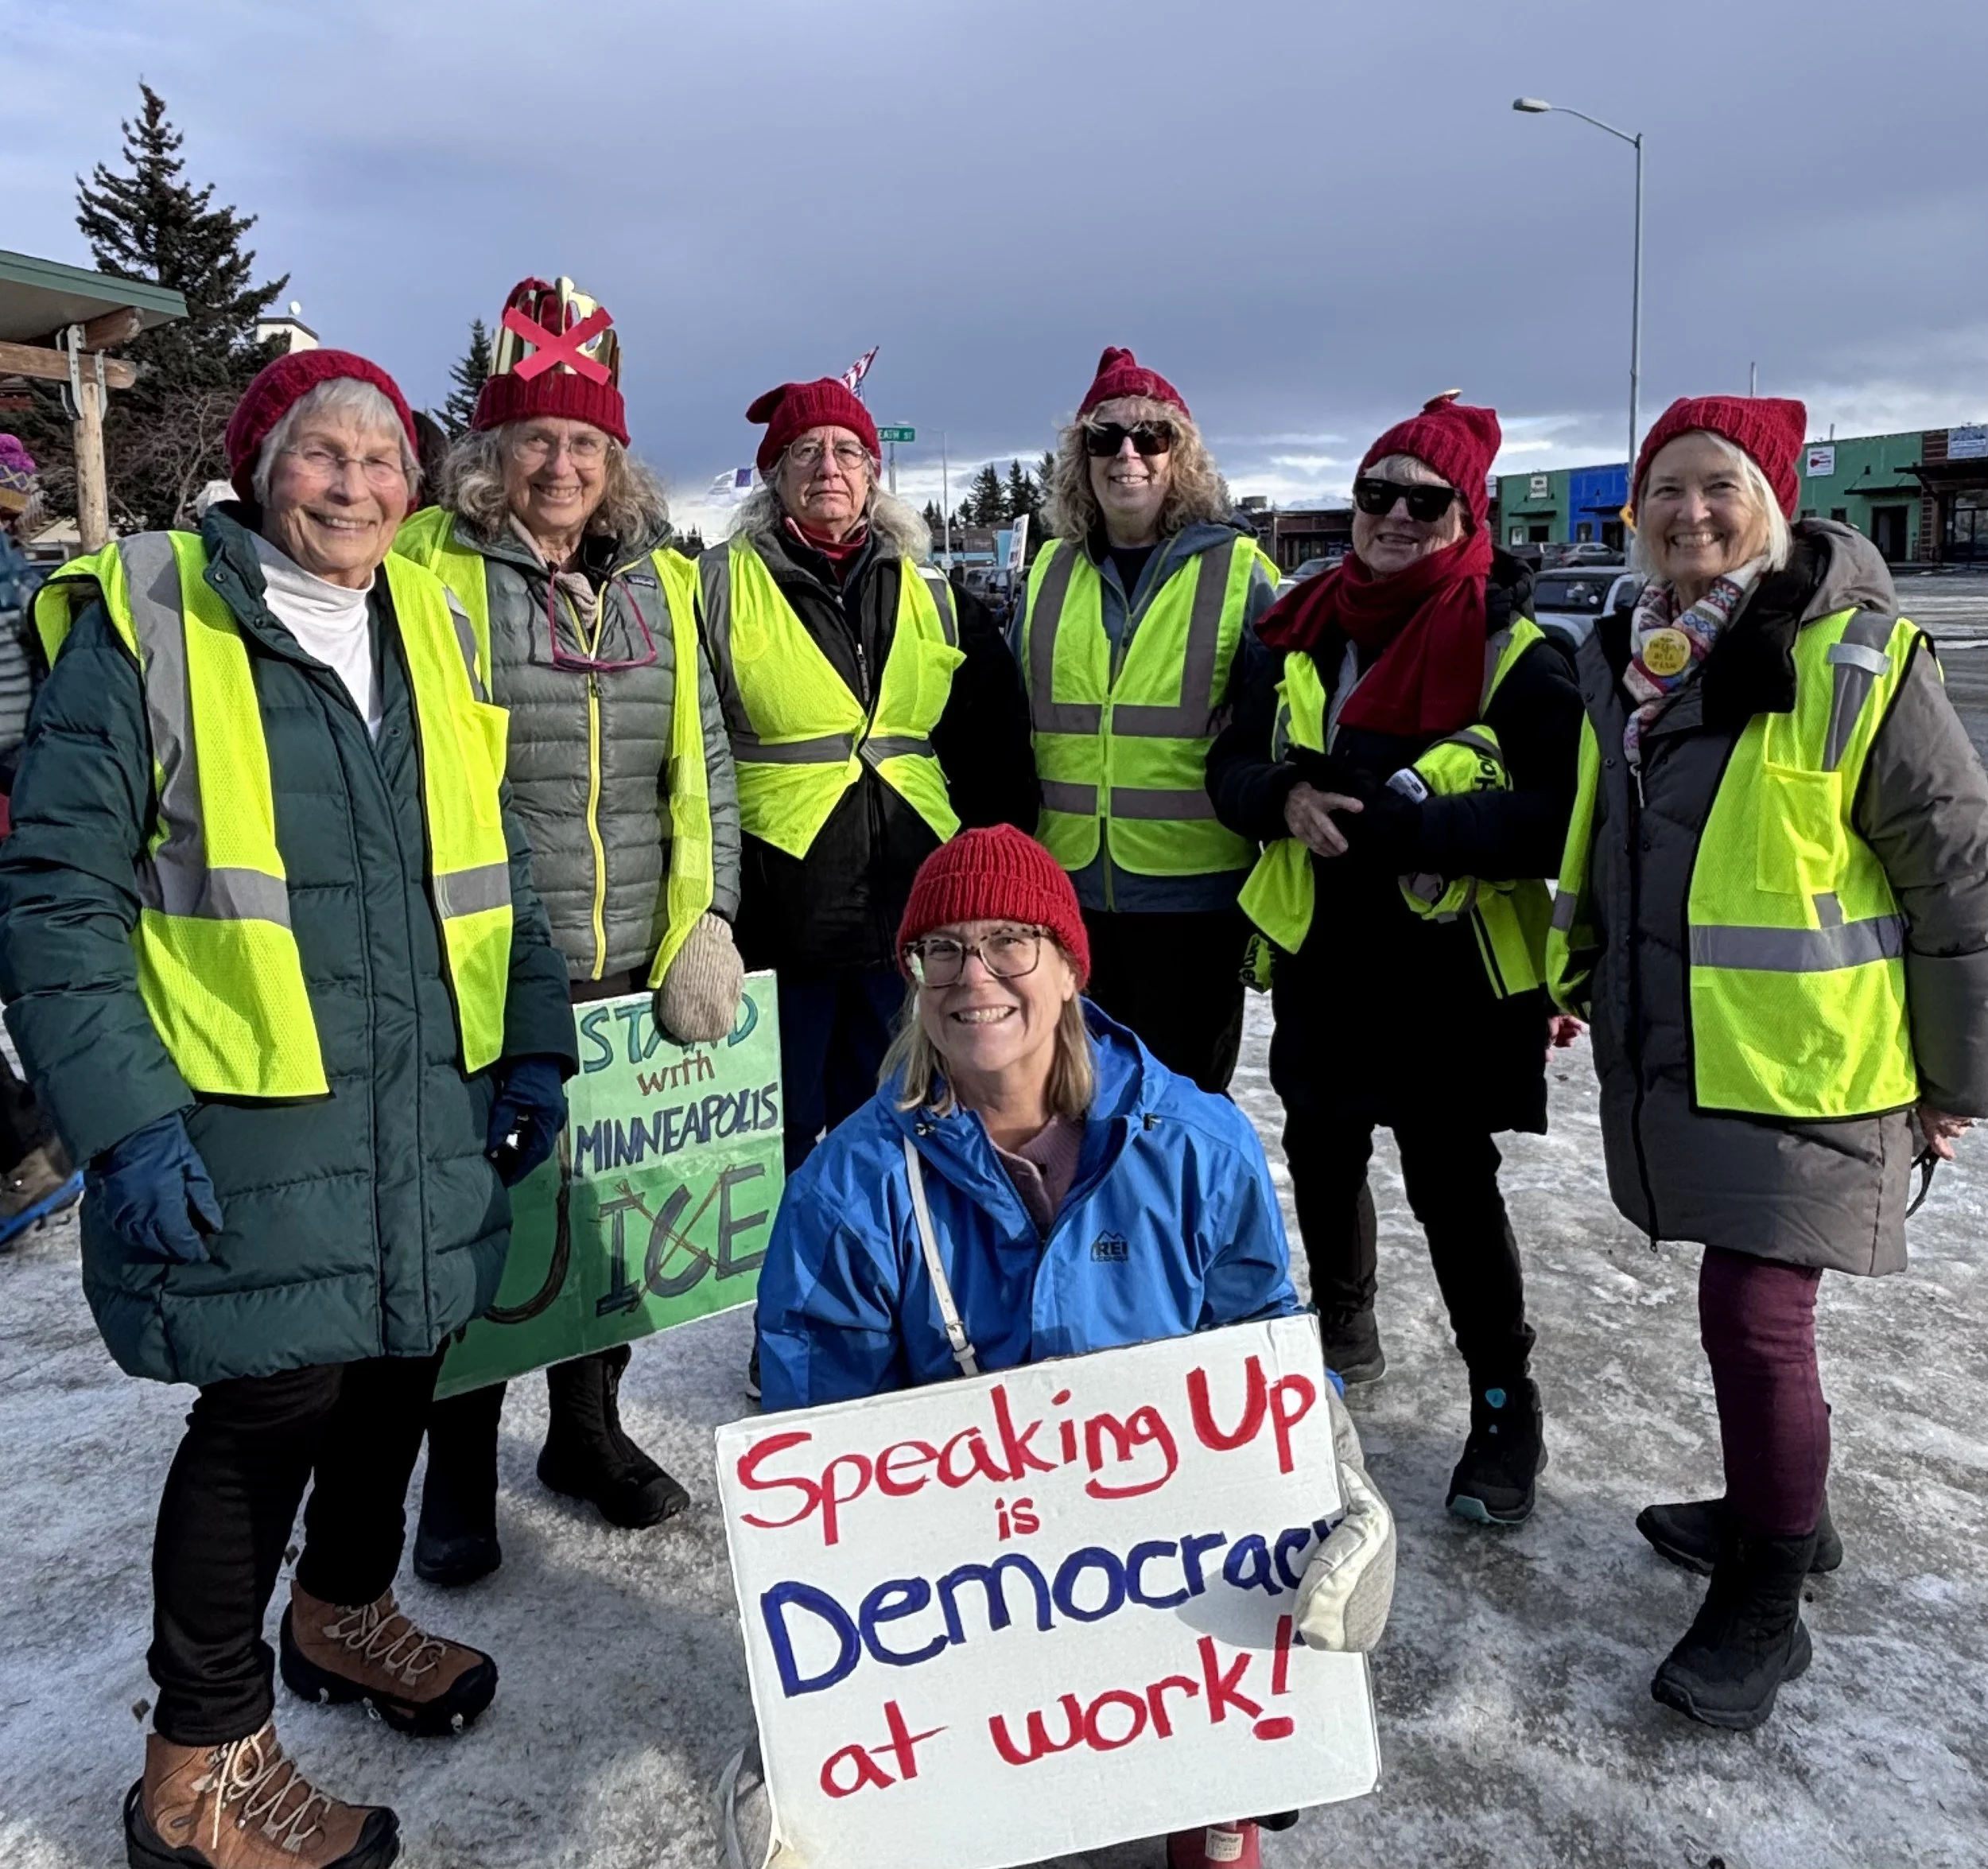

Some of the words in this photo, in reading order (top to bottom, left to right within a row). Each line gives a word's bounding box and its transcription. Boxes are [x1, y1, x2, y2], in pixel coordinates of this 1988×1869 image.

[876, 429, 899, 440] EATH
[580, 992, 759, 1074] STD
[573, 1082, 779, 1177] MINNEAPOLIS
[595, 1163, 768, 1318] ICE
[1096, 1241, 1128, 1256] REI
[737, 1385, 1179, 1545] Speaking
[1186, 1355, 1317, 1474] Up
[993, 1497, 1040, 1541] is
[760, 1517, 1344, 1697] Democrac
[821, 1700, 946, 1799] at
[989, 1614, 1295, 1766] work!
